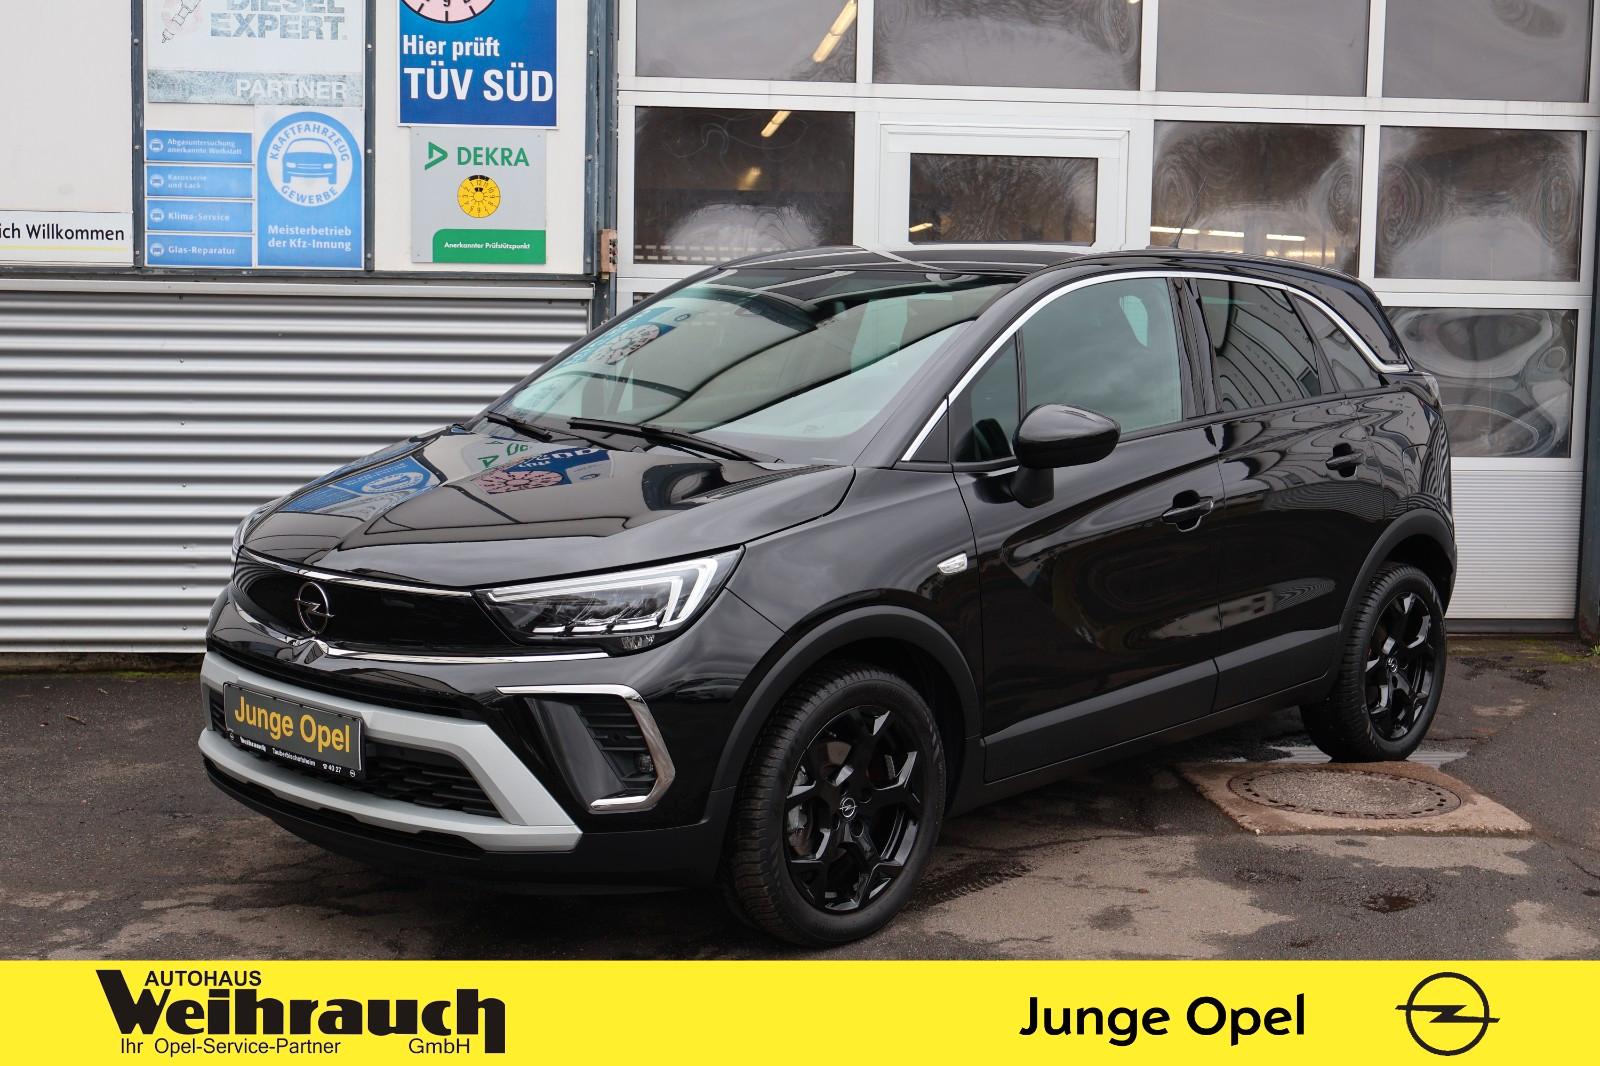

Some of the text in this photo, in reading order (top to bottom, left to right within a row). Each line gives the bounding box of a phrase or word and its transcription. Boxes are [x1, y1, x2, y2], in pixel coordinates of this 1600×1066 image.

[210, 13, 346, 40] EXPERT
[403, 35, 500, 61] Hier prüft
[236, 79, 347, 99] PARTNER
[404, 60, 553, 101] TÜV SÜD
[269, 123, 350, 162] KRAFTFAHRZEUG
[457, 146, 530, 167] DEKRA
[281, 185, 338, 205] GEWERBE
[168, 212, 231, 221] Klima-Service
[26, 223, 124, 240] Willkommen
[268, 225, 352, 236] Meisterbetrieb
[168, 245, 235, 256] Glas-Reparatur
[268, 238, 352, 251] der Kfz-Innung
[444, 241, 531, 250] Anerkannter Prüfstützpunkt
[234, 696, 350, 753] Junge Opel
